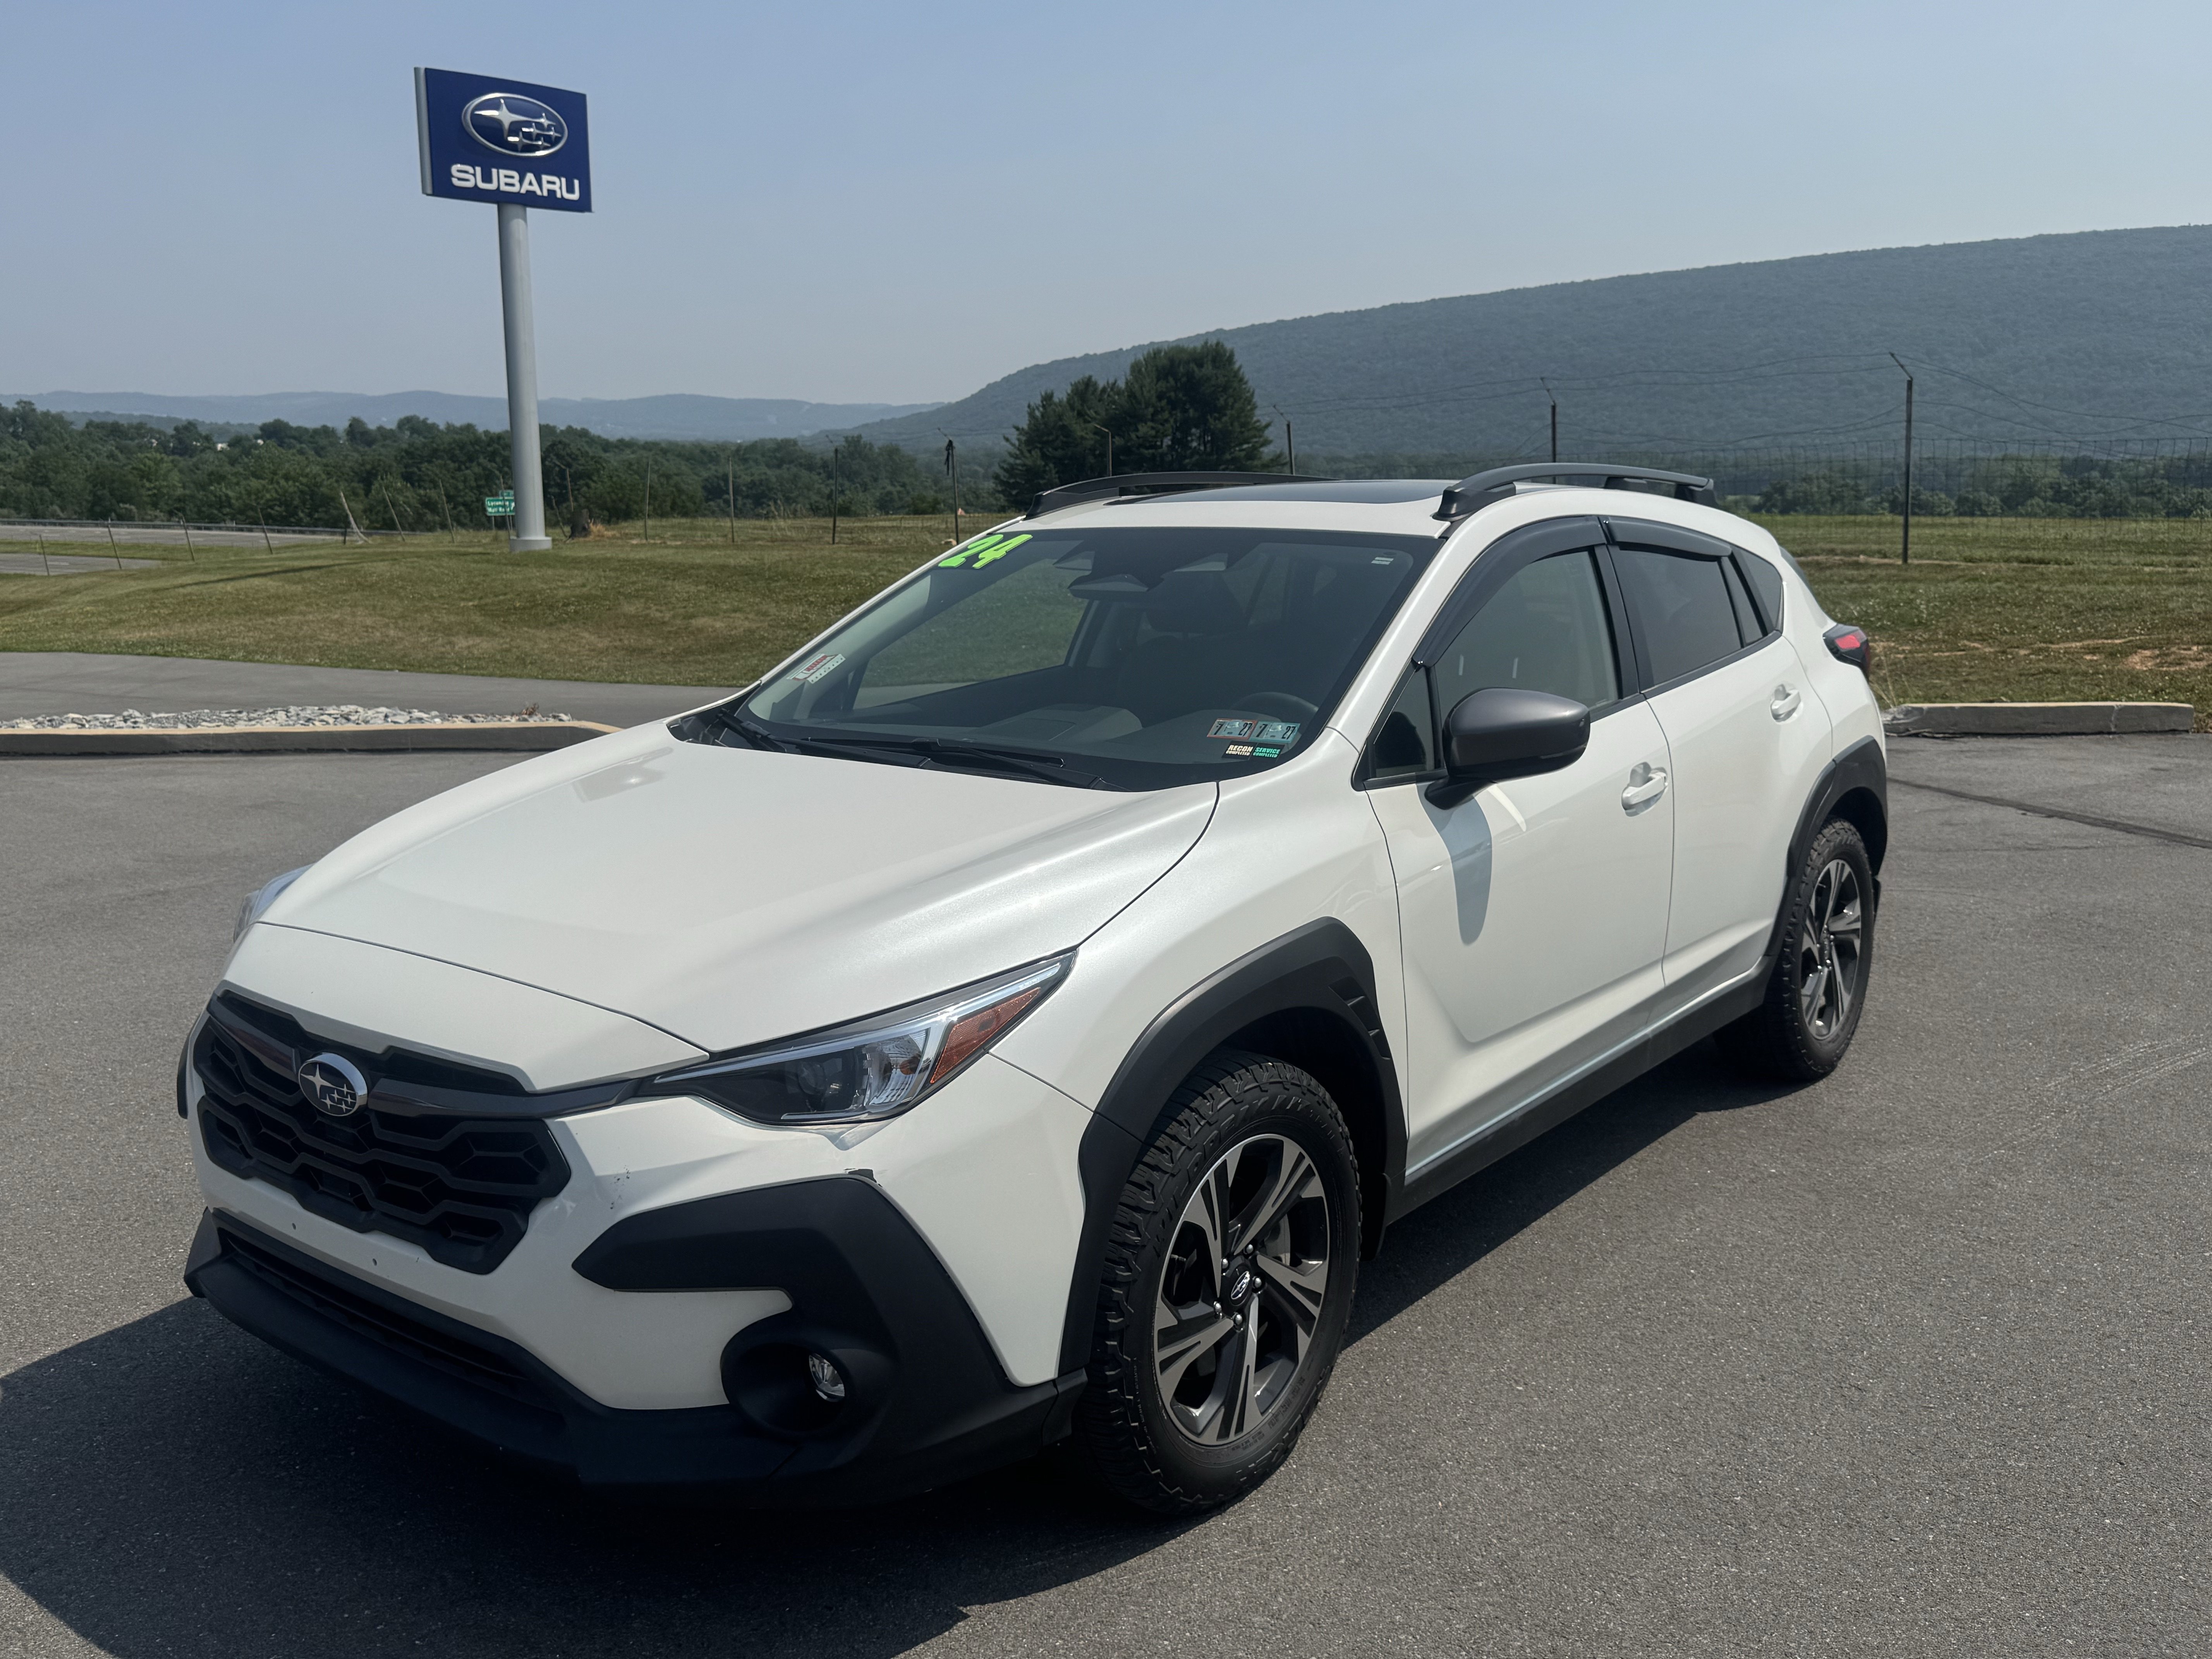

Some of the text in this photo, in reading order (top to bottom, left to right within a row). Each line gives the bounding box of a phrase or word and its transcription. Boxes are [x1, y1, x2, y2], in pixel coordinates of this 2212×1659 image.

[451, 163, 579, 201] SUBARU
[938, 534, 1033, 569] 24
[1238, 722, 1253, 737] 27
[1281, 726, 1296, 740] 27
